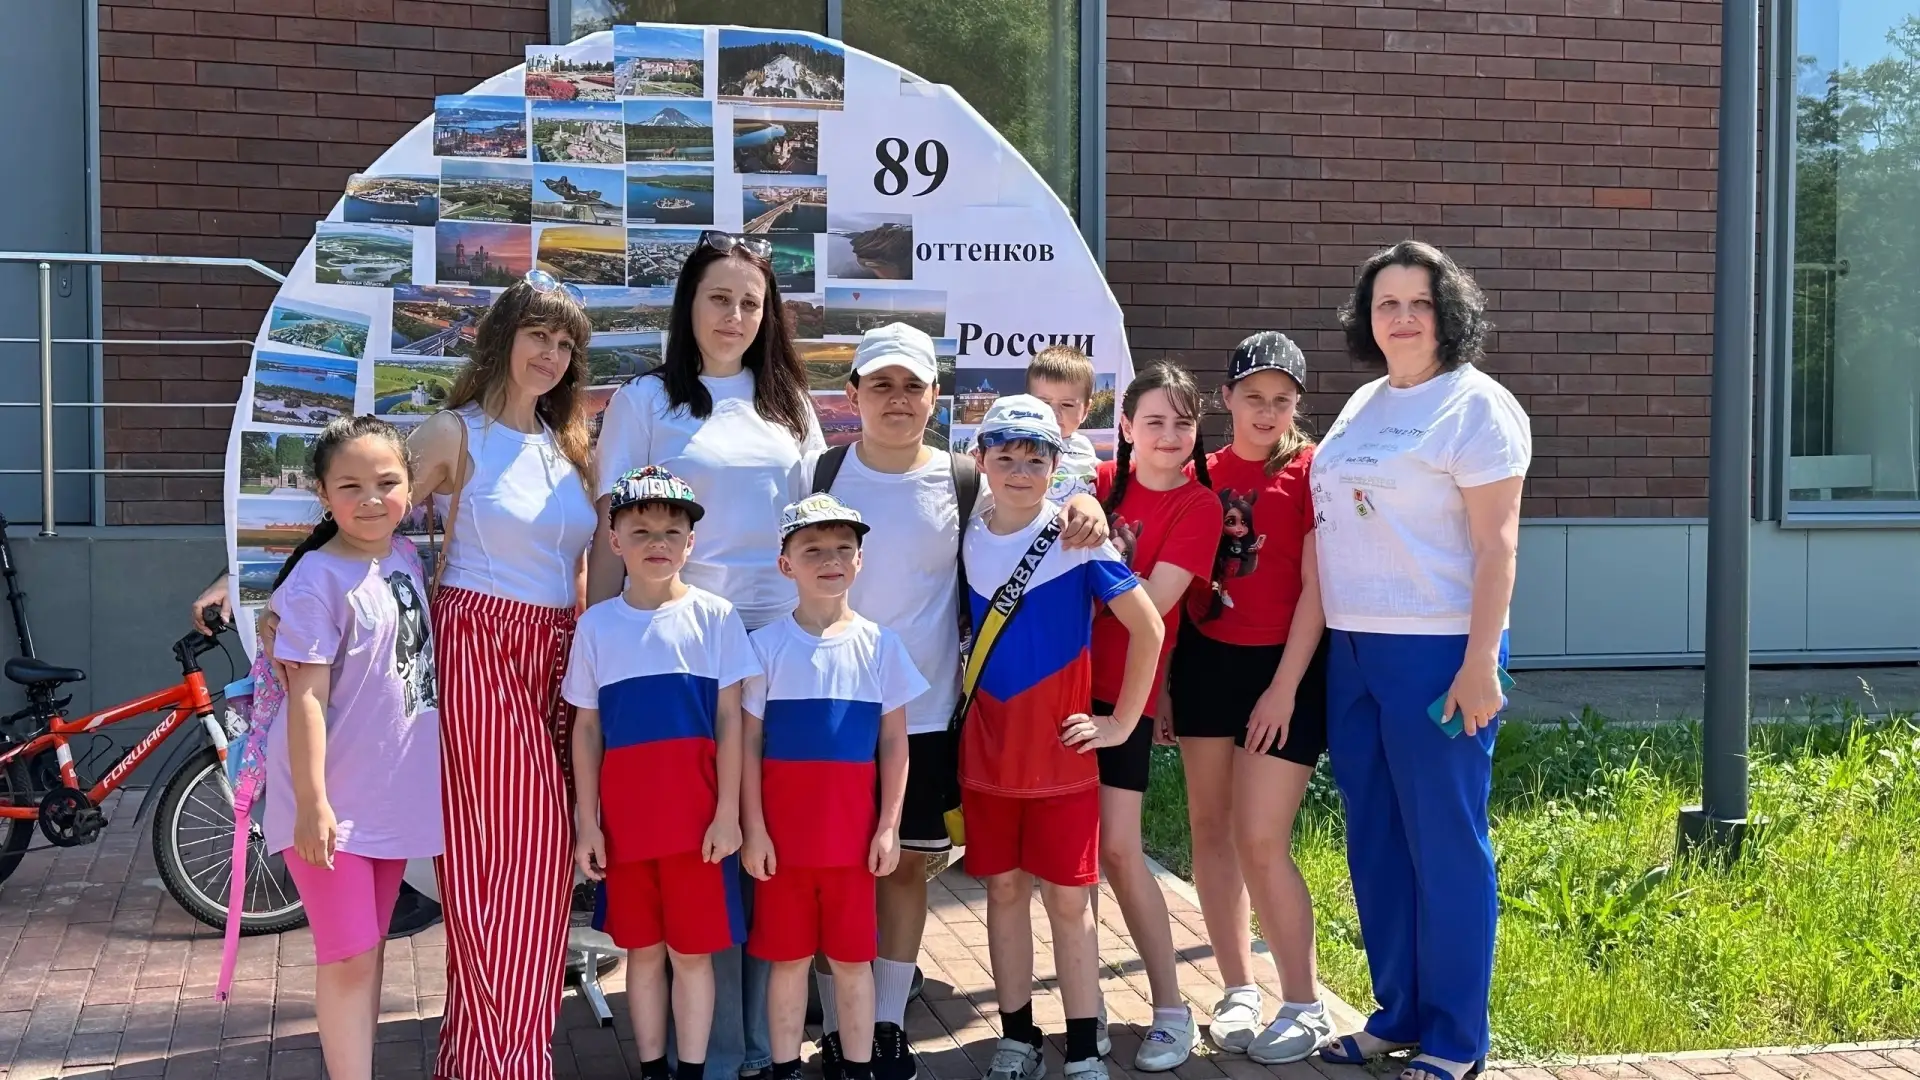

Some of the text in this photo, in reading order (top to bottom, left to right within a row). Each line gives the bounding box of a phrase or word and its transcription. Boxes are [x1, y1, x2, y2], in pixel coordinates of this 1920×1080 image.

[873, 137, 949, 197] 89
[916, 242, 1054, 262] оттенков
[957, 322, 1095, 358] России
[102, 710, 177, 789] FORWARD
